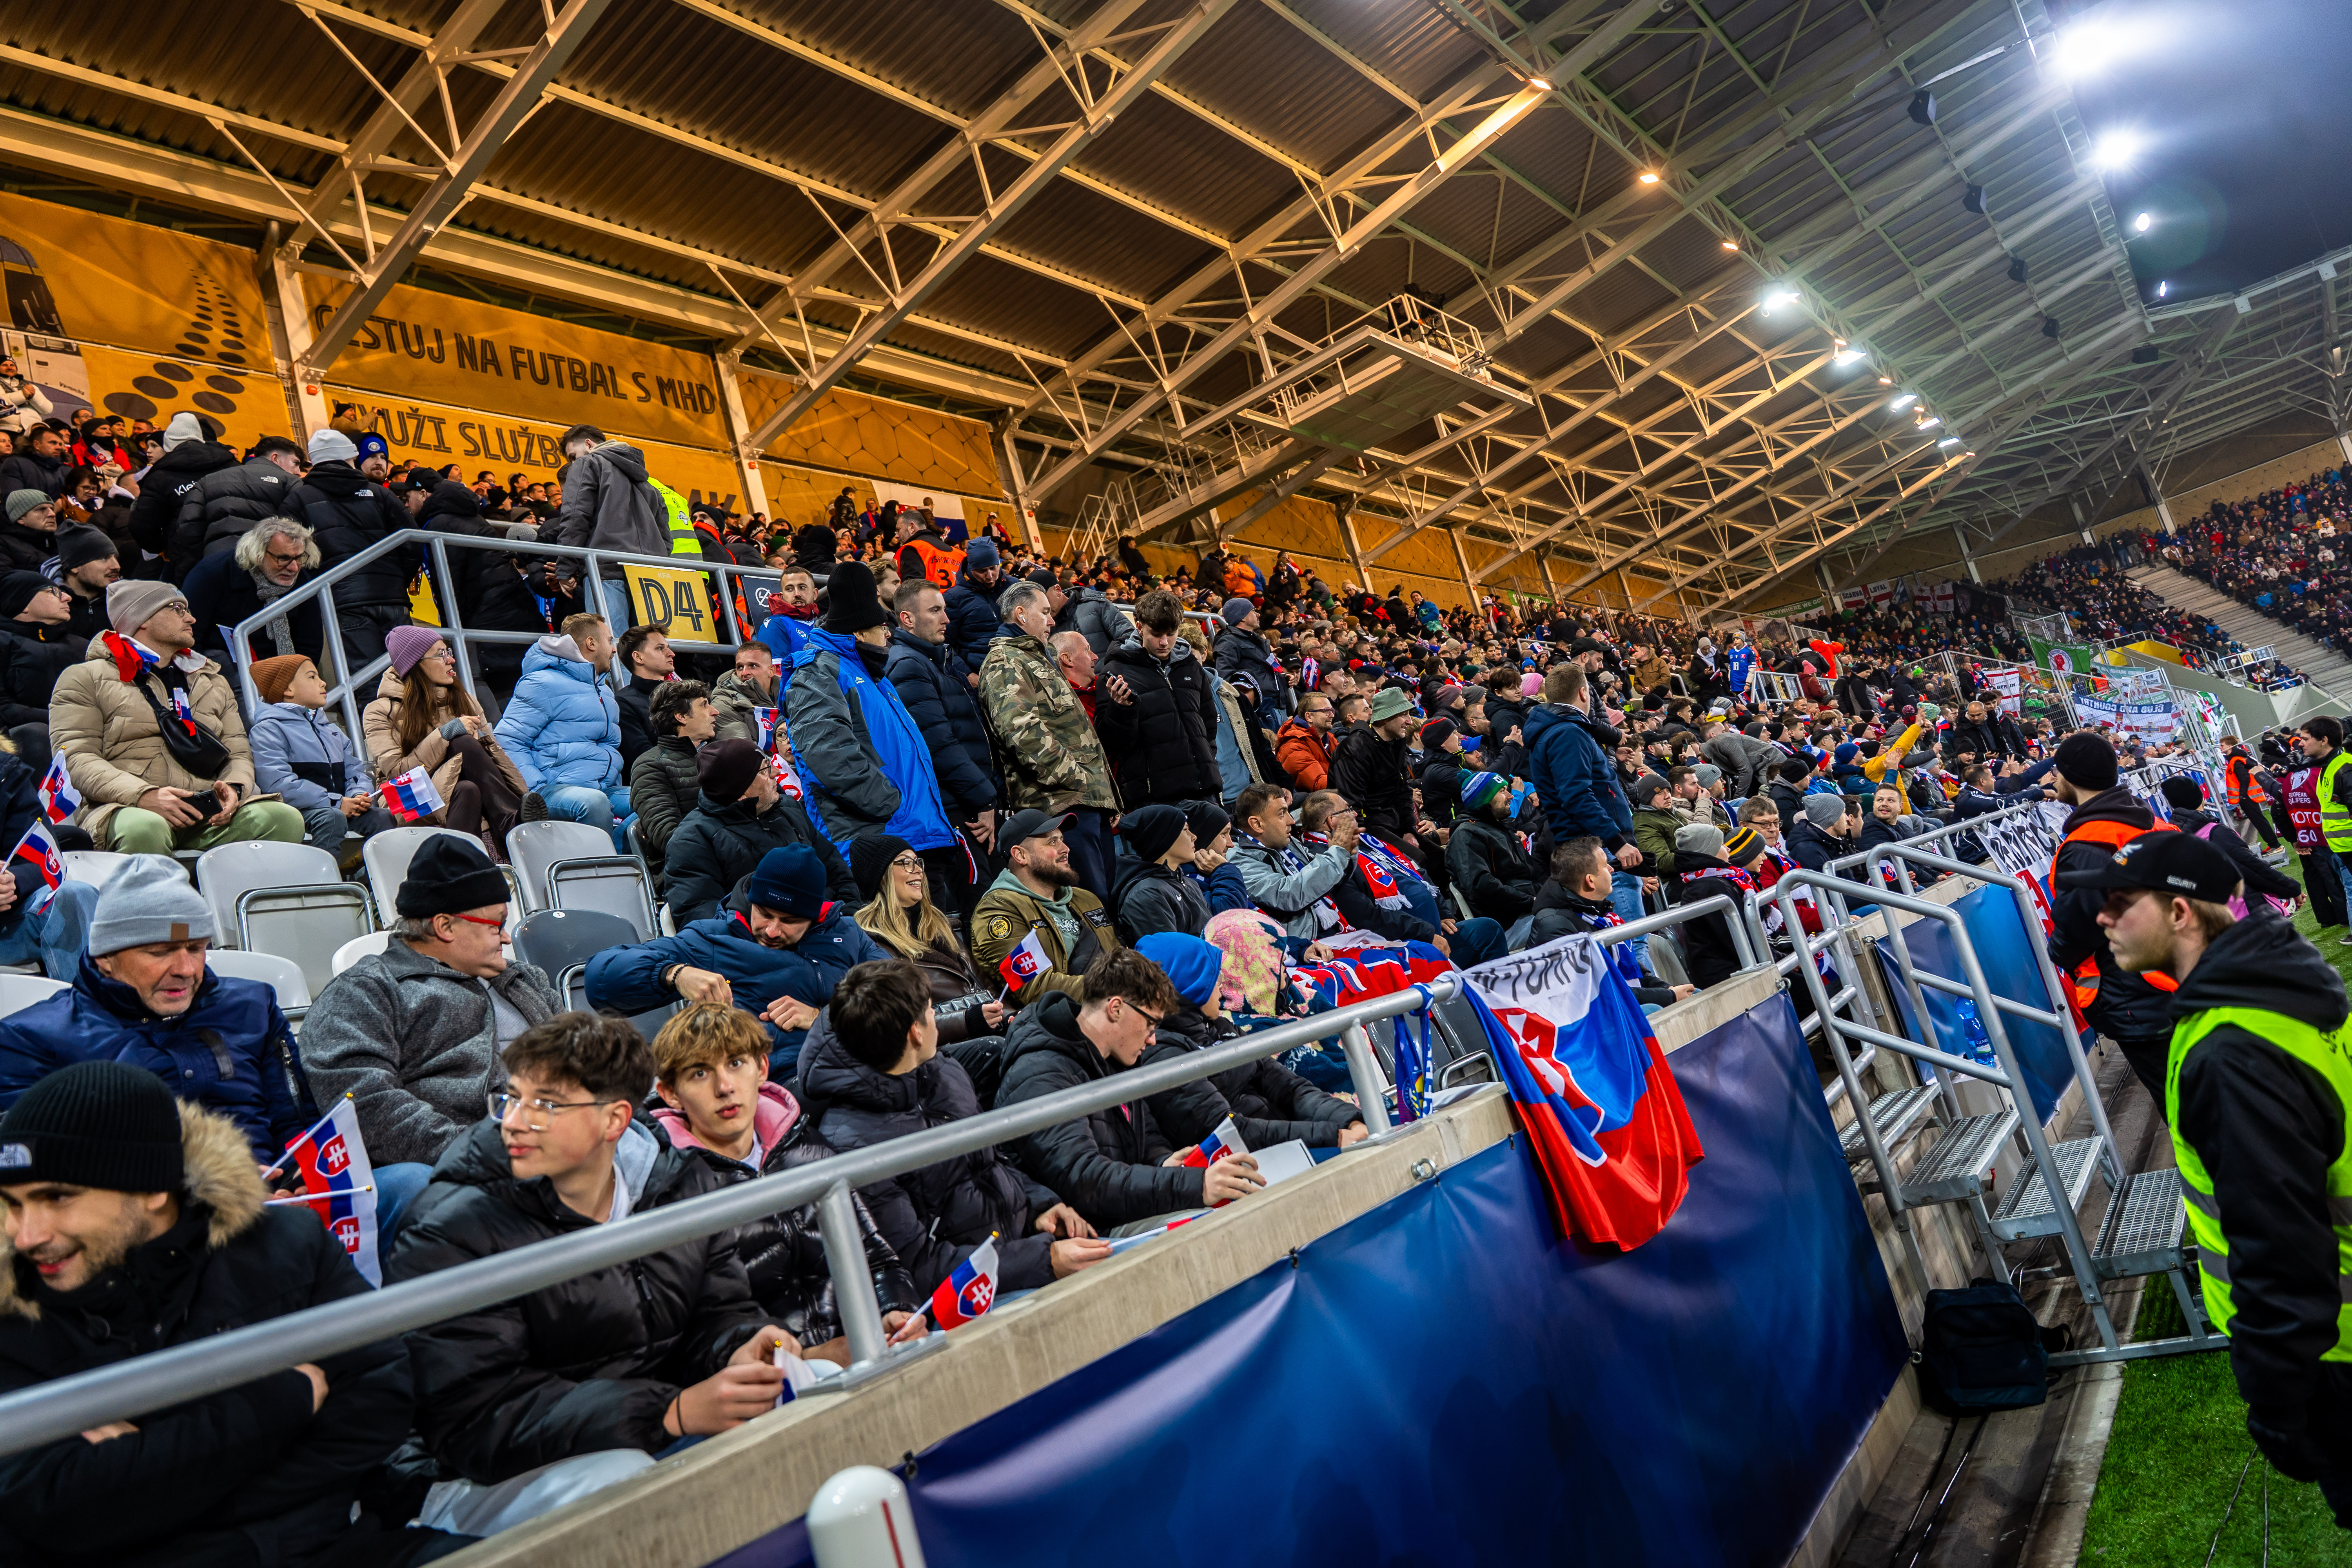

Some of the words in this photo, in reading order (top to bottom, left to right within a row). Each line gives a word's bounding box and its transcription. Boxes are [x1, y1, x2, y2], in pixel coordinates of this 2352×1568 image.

[316, 305, 445, 364] CSTUJ
[454, 333, 503, 377] NA
[510, 345, 628, 400] FUTBAL
[632, 372, 651, 403] S
[656, 376, 715, 415] MHD
[458, 422, 561, 469] SLUŽB
[174, 480, 197, 496] Klei
[1842, 590, 1863, 599] SCARVA
[1869, 584, 1887, 593] LOYAL
[638, 577, 704, 632] D4
[1763, 604, 1802, 618] EVERYWHERE
[1802, 601, 1812, 610] WE
[1733, 662, 1739, 671] 18
[2297, 829, 2318, 842] 60
[2166, 875, 2197, 891] SECURITY
